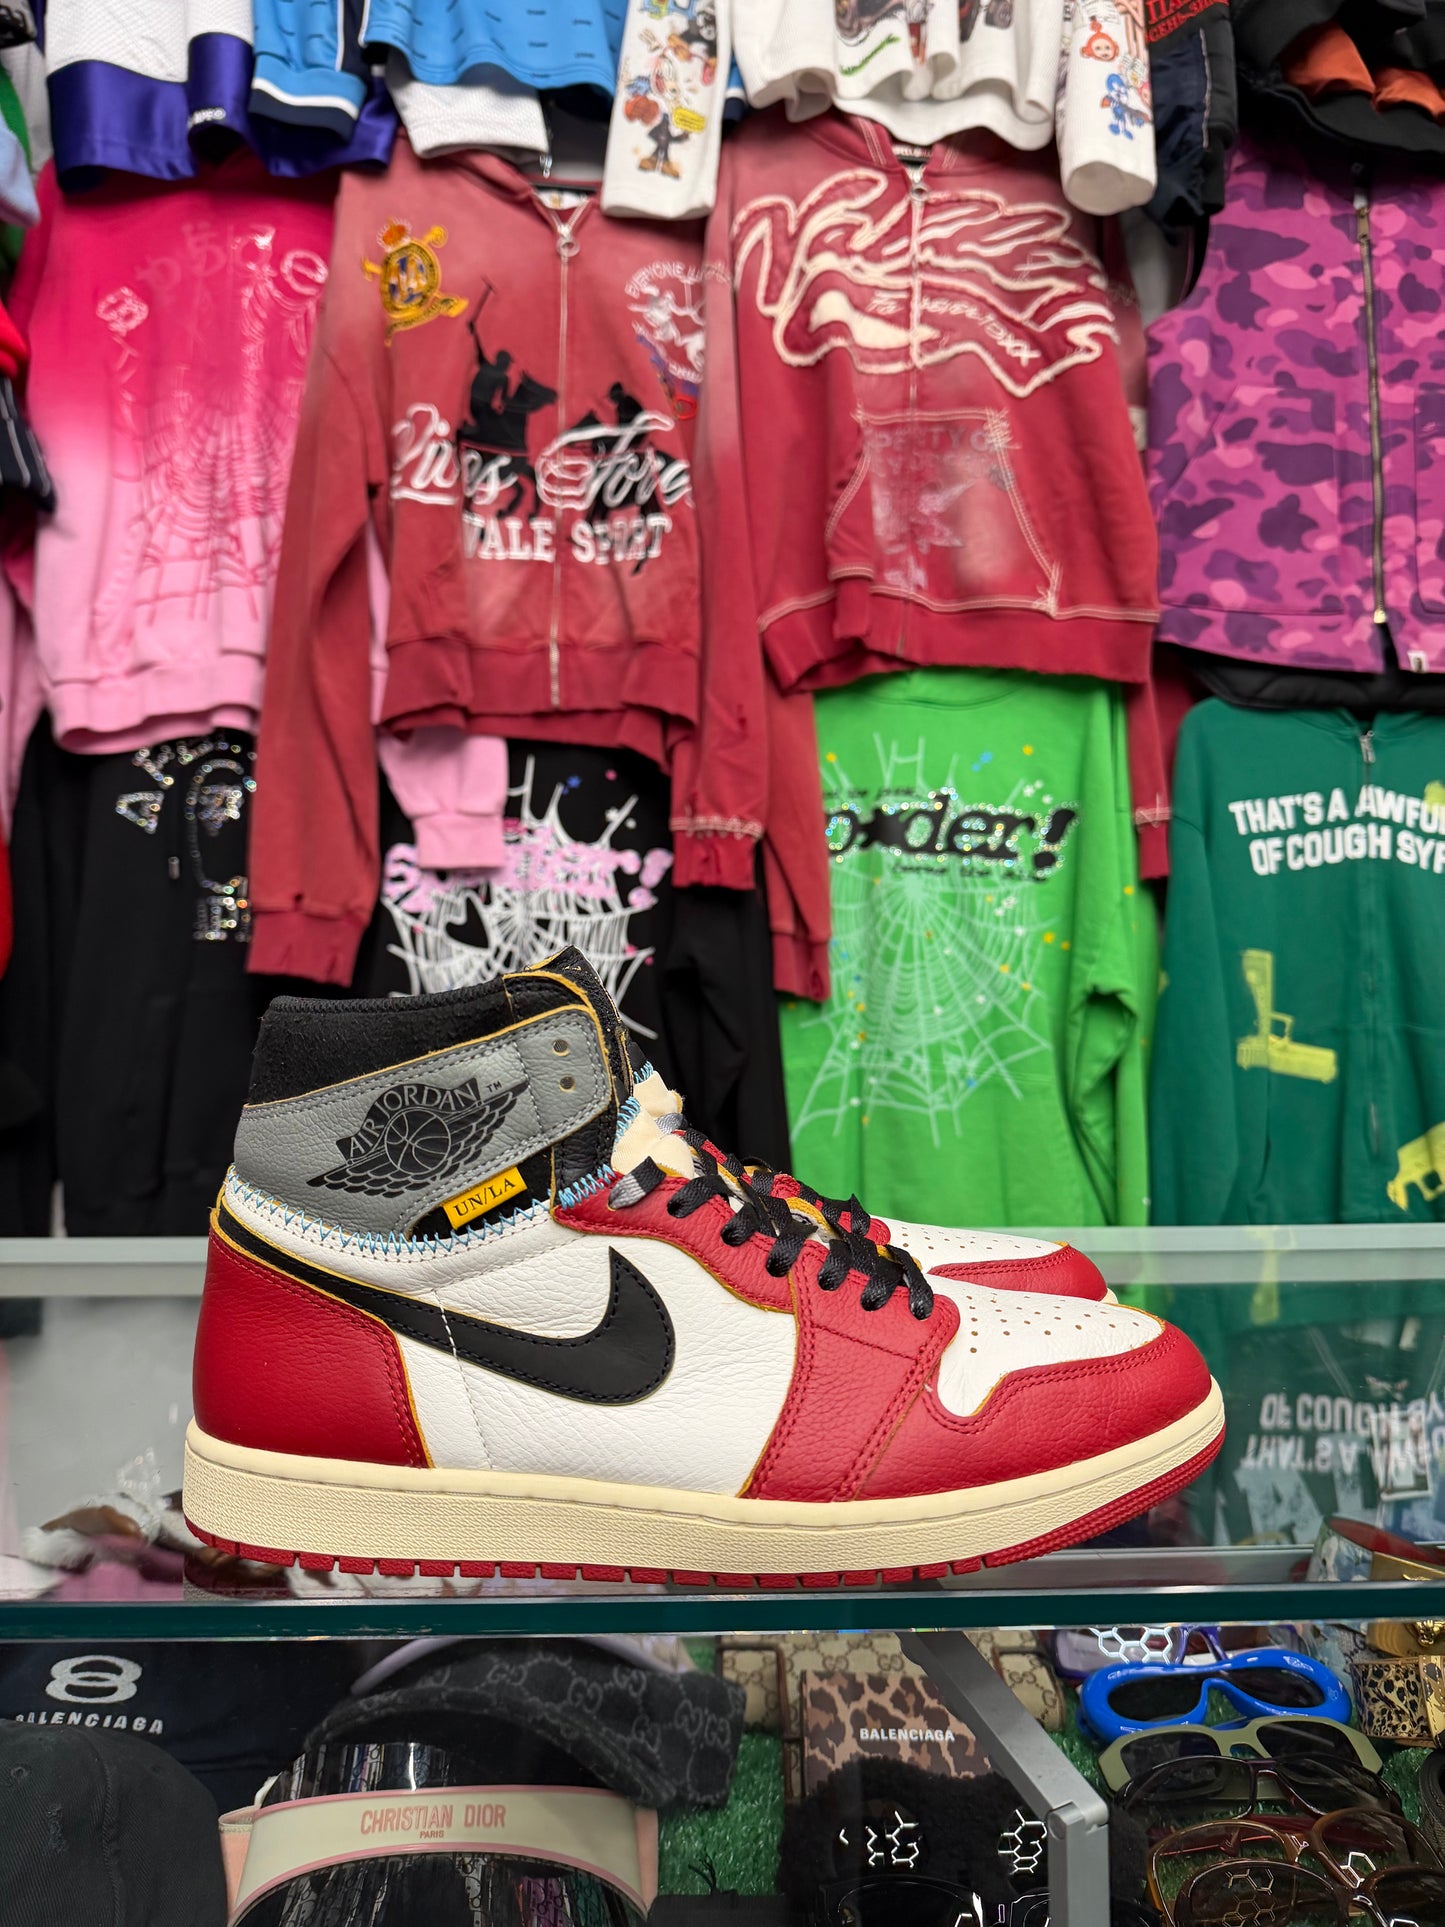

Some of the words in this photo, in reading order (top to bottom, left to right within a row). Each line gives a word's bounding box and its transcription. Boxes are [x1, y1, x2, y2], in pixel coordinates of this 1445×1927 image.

[1228, 792, 1324, 836] THAT'S
[1326, 787, 1349, 822] A
[1250, 837, 1284, 876] OF
[1286, 822, 1392, 871] COUGH
[349, 1117, 385, 1157] AIR
[374, 1081, 480, 1121] JORDAN
[453, 1177, 517, 1217] UN/LA
[859, 1727, 956, 1743] BALENCIAGA
[360, 1804, 454, 1836] CHRISTIAN
[463, 1803, 507, 1829] DIOR
[419, 1830, 445, 1840] PARIS
